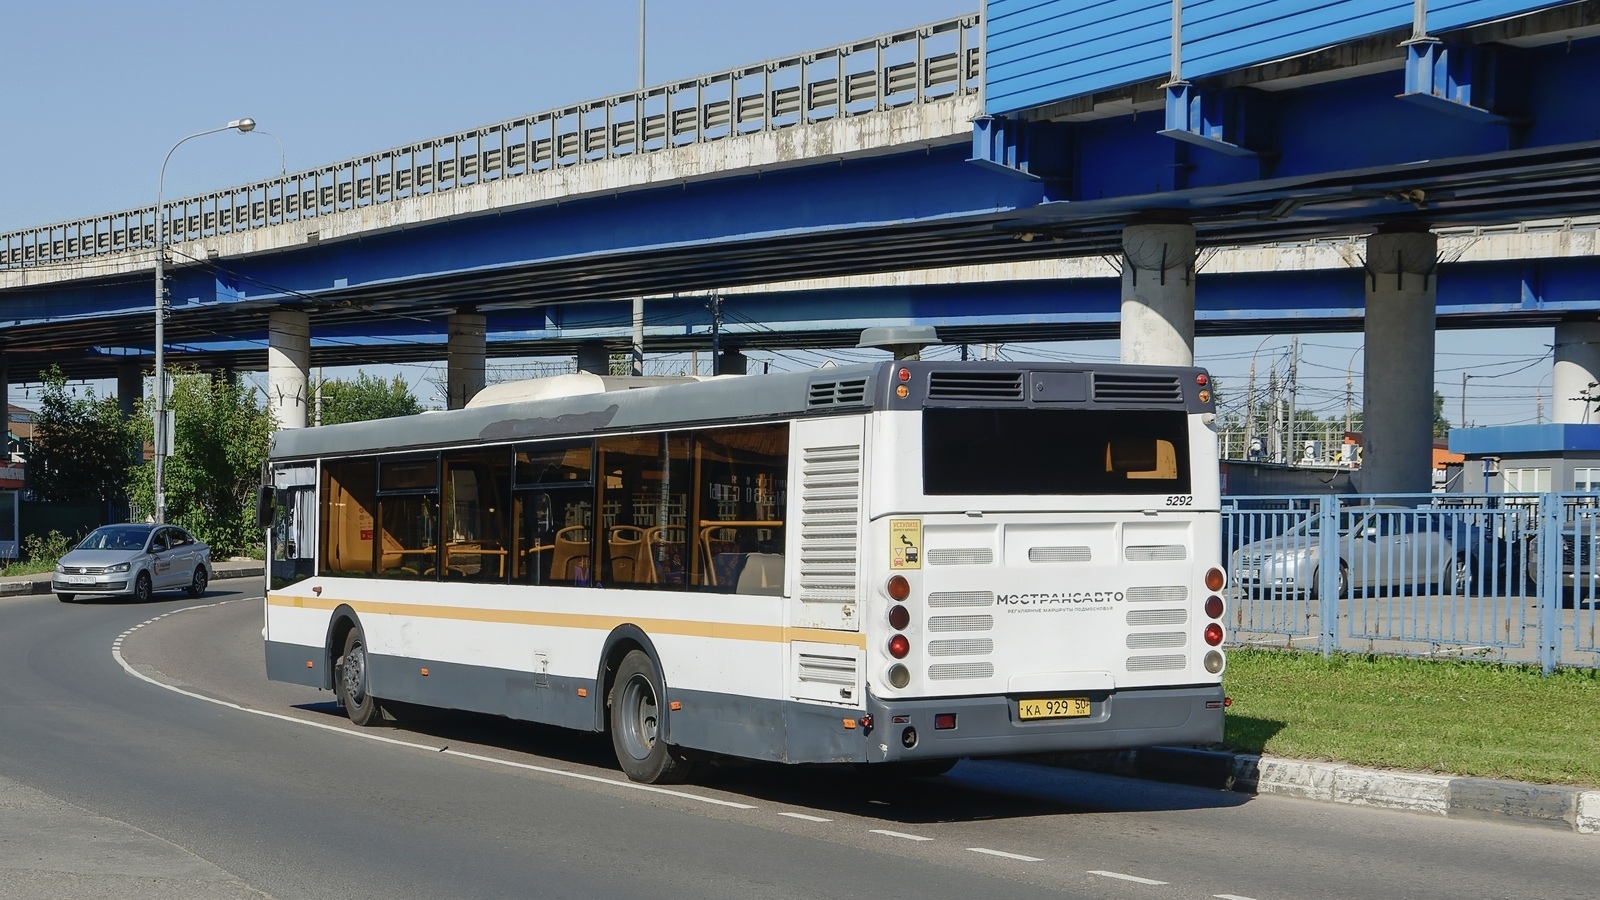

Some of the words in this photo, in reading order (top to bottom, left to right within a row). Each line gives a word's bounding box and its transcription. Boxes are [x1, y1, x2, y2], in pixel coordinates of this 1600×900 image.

[1166, 495, 1193, 506] 5292
[996, 591, 1124, 605] МОСТРАНСАВТО
[1026, 704, 1041, 716] КА
[1046, 700, 1068, 715] 929
[1075, 698, 1086, 709] 50
